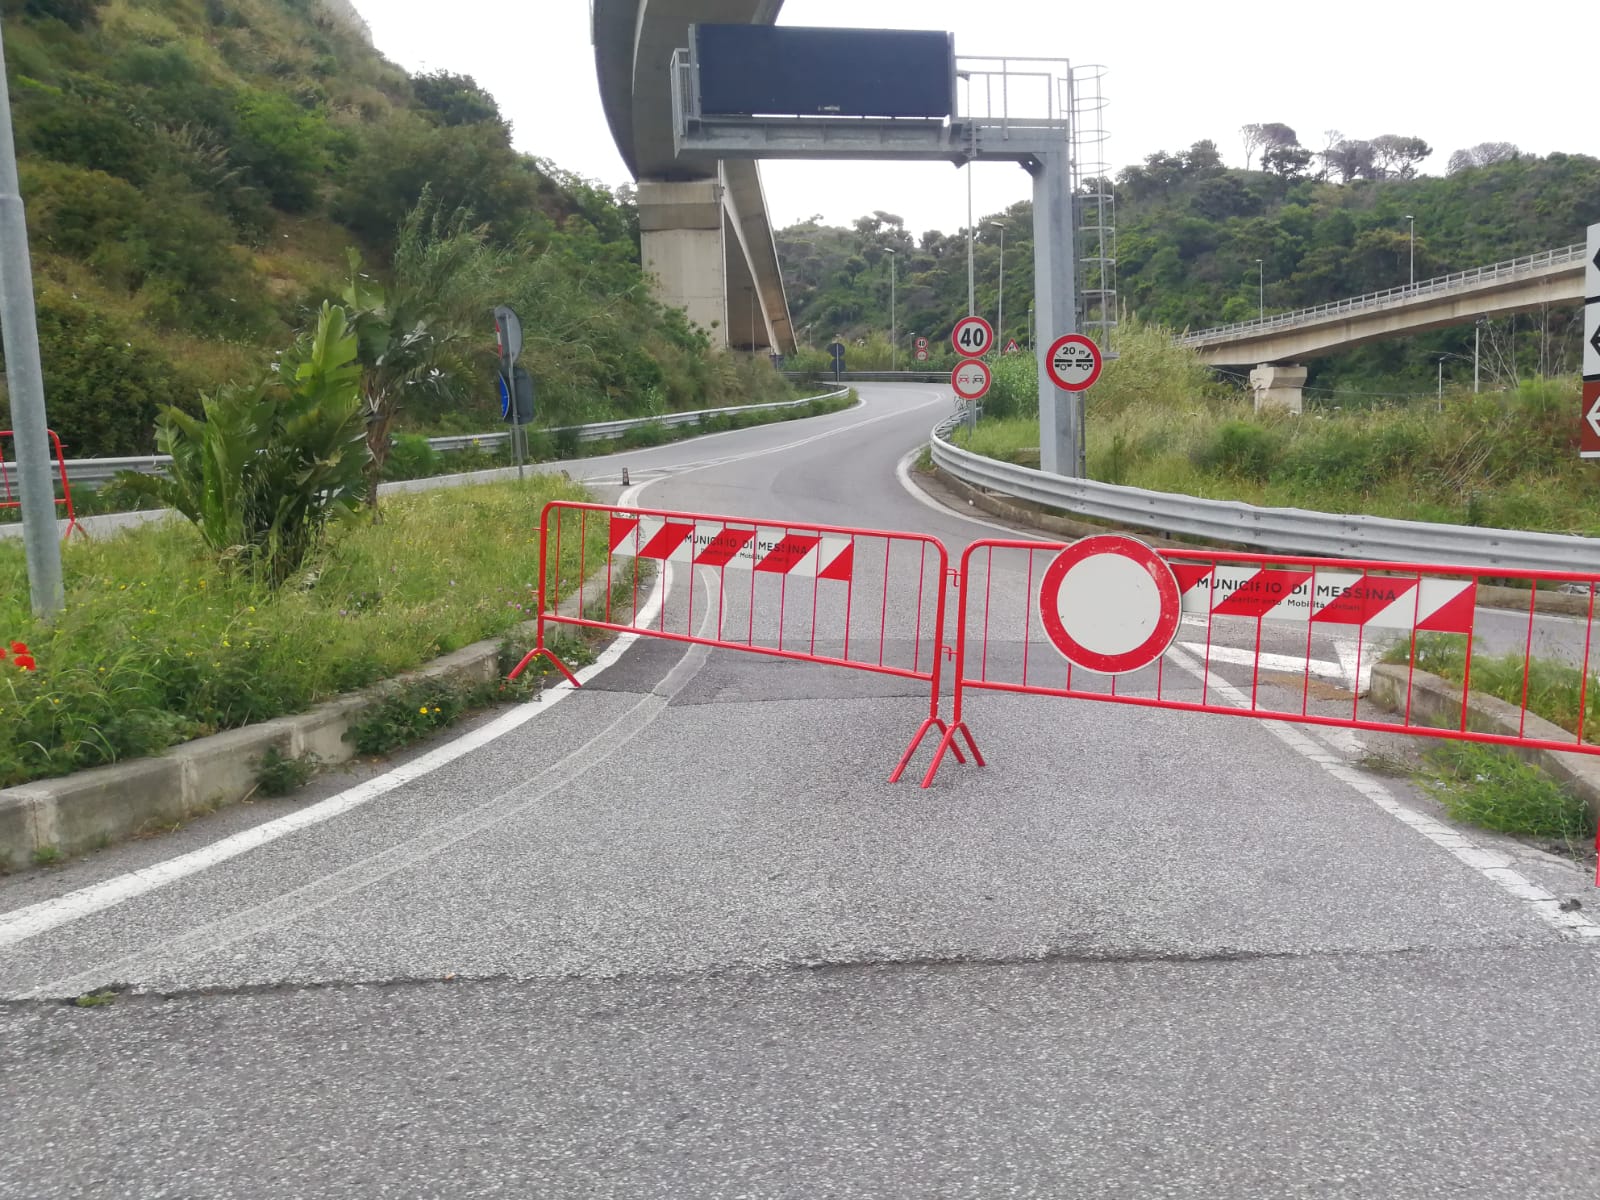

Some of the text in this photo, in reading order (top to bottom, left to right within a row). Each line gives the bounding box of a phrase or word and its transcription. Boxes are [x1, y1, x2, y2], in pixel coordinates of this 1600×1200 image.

[960, 328, 984, 346] 40
[1062, 346, 1076, 355] 20
[742, 540, 753, 550] DI
[1291, 583, 1308, 595] DI
[1316, 585, 1396, 601] MESSINA
